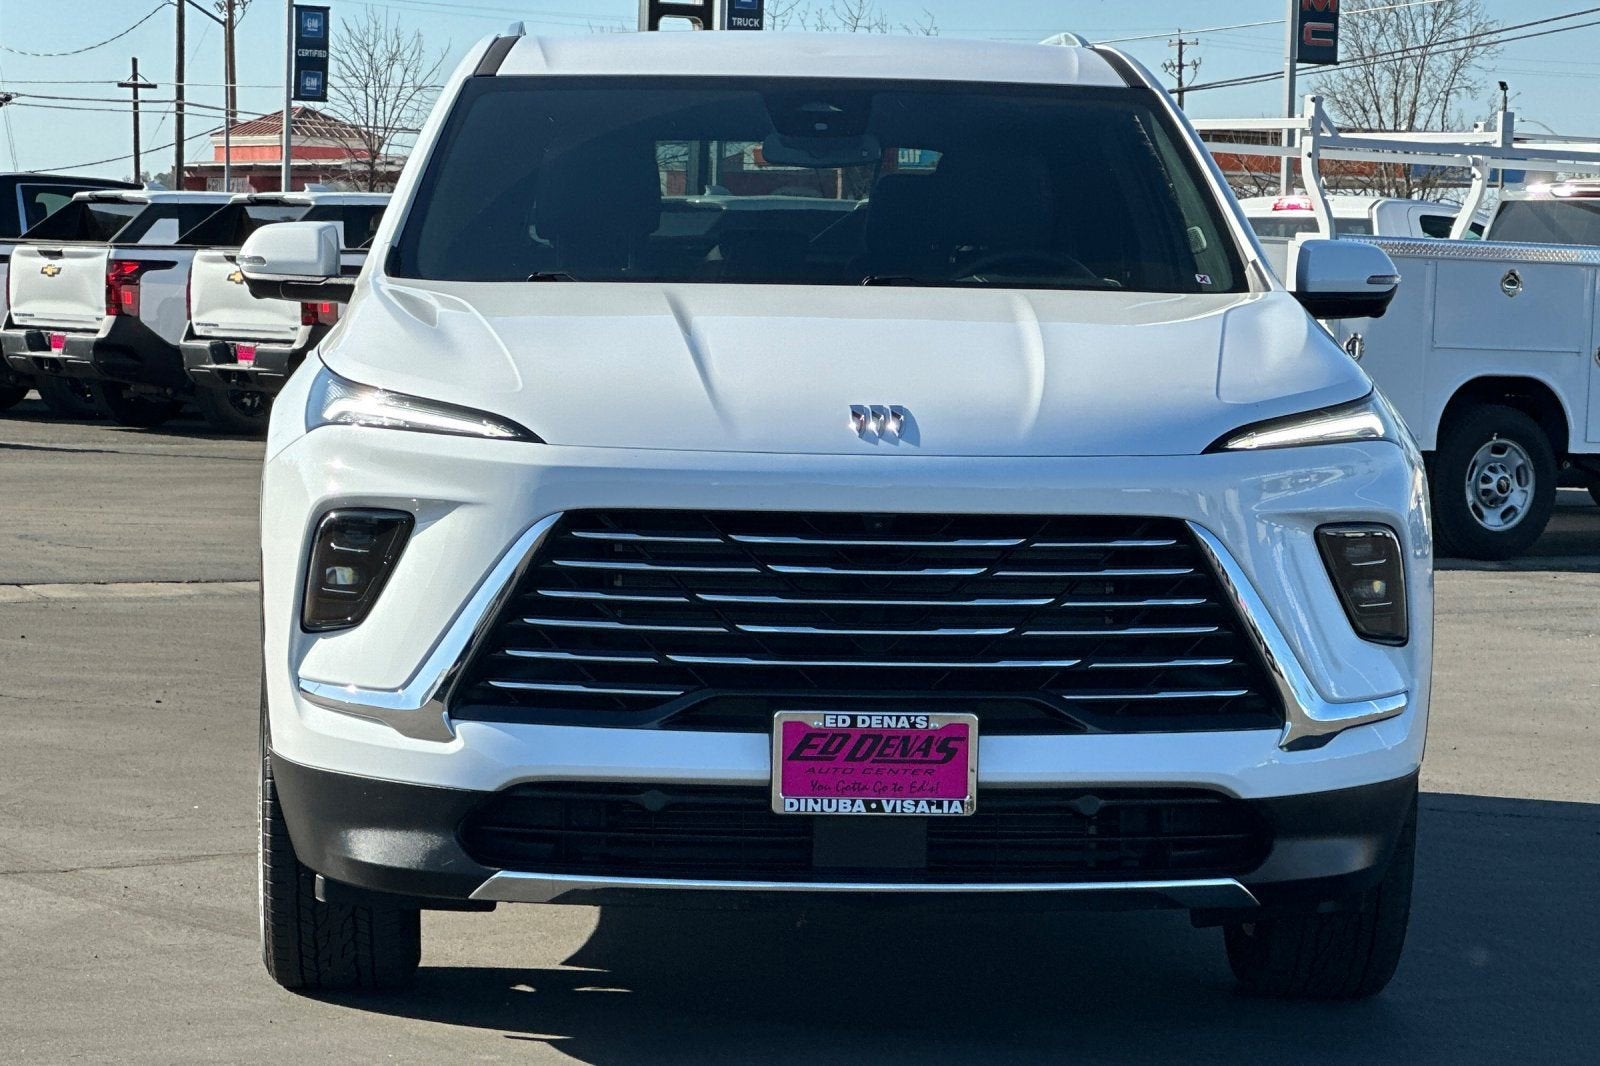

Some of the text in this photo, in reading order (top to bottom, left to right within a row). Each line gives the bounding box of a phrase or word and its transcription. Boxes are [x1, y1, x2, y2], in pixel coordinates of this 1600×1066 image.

[731, 17, 760, 27] TRUCK
[297, 49, 327, 58] CERTIFIED
[825, 715, 928, 729] ED DENA'S
[787, 733, 966, 764] ED DENA'S
[805, 767, 936, 776] AUTO CENTER
[810, 780, 941, 794] You Gotta Go to Ed's!
[784, 799, 964, 814] DINUBA VISALIA
